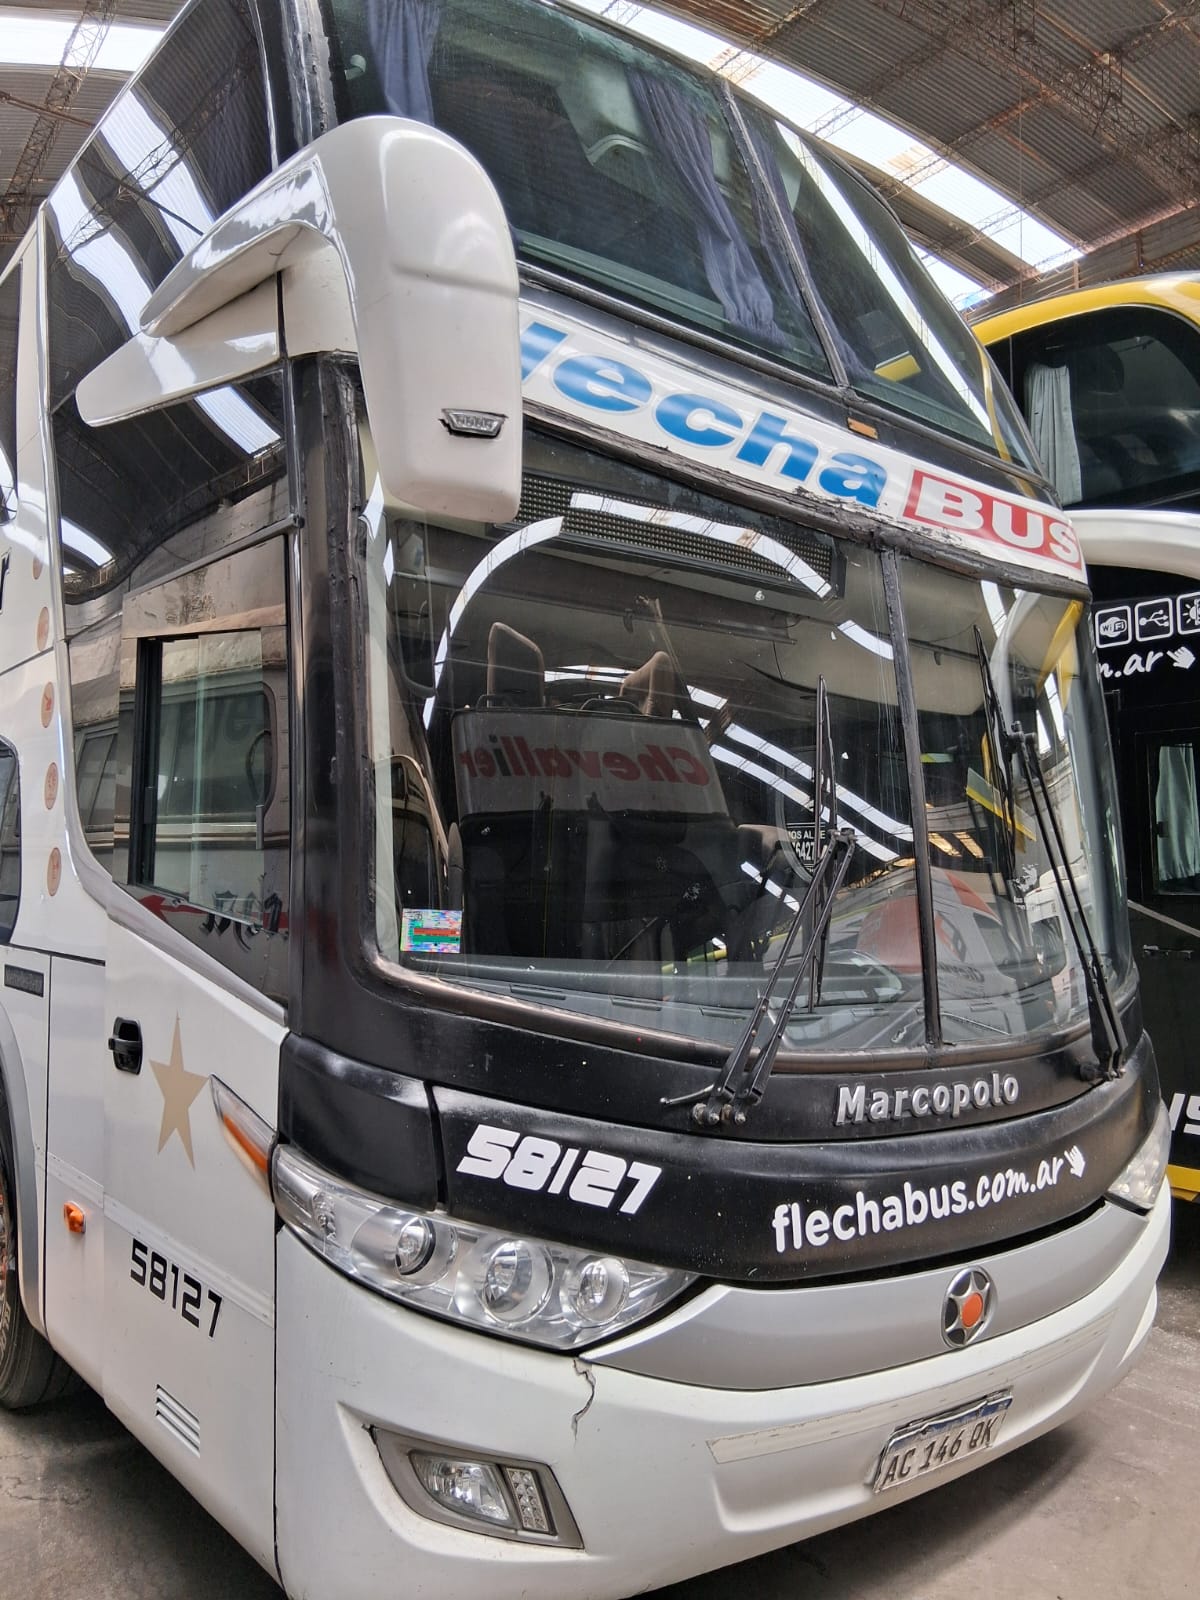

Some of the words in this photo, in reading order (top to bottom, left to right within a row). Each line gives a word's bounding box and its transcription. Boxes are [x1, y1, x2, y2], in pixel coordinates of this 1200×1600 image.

[915, 476, 1079, 565] BUS
[834, 1072, 1019, 1126] Marcopolo
[456, 1124, 662, 1214] 58127
[772, 1157, 1064, 1253] flechabus.com.ar
[130, 1238, 222, 1338] 58127
[882, 1447, 916, 1487] AC
[918, 1430, 965, 1472] 146
